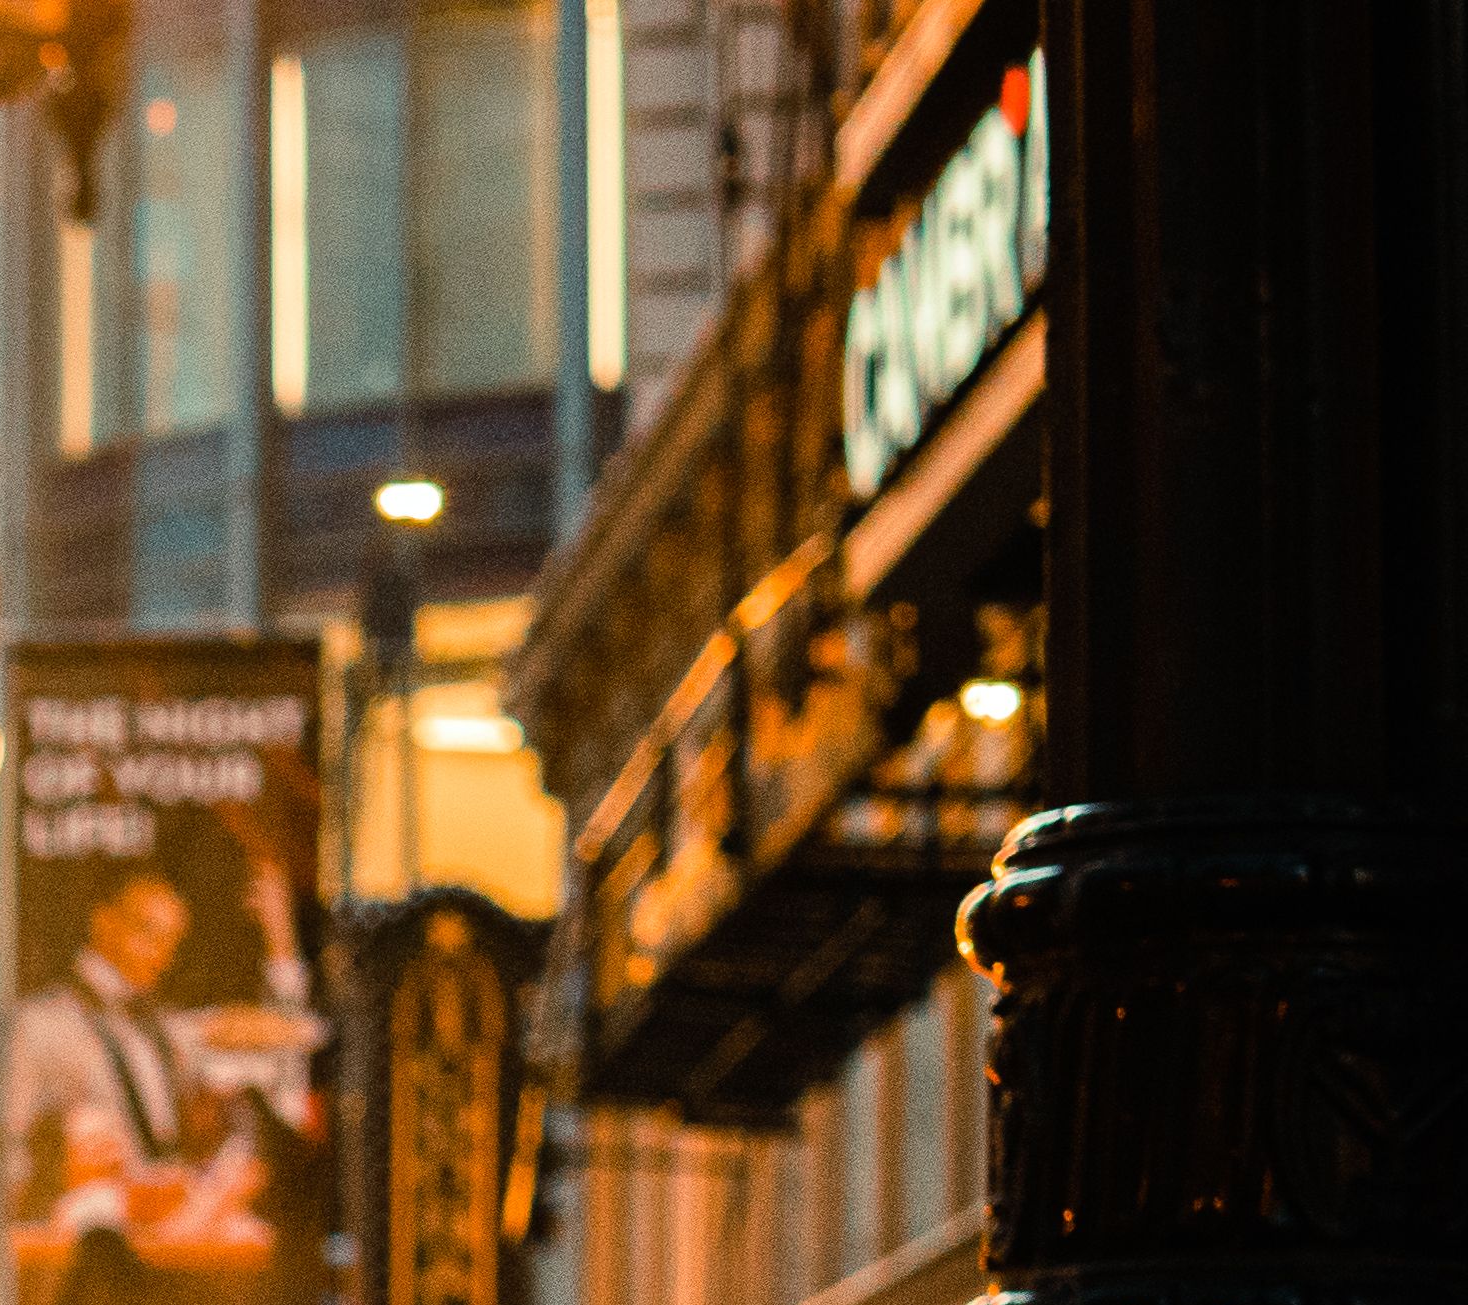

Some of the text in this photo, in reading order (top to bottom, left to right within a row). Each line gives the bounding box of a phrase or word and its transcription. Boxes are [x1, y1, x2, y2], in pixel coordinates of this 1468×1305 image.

[28, 694, 304, 746] THE NIGHT
[24, 752, 266, 803] OF YOUR
